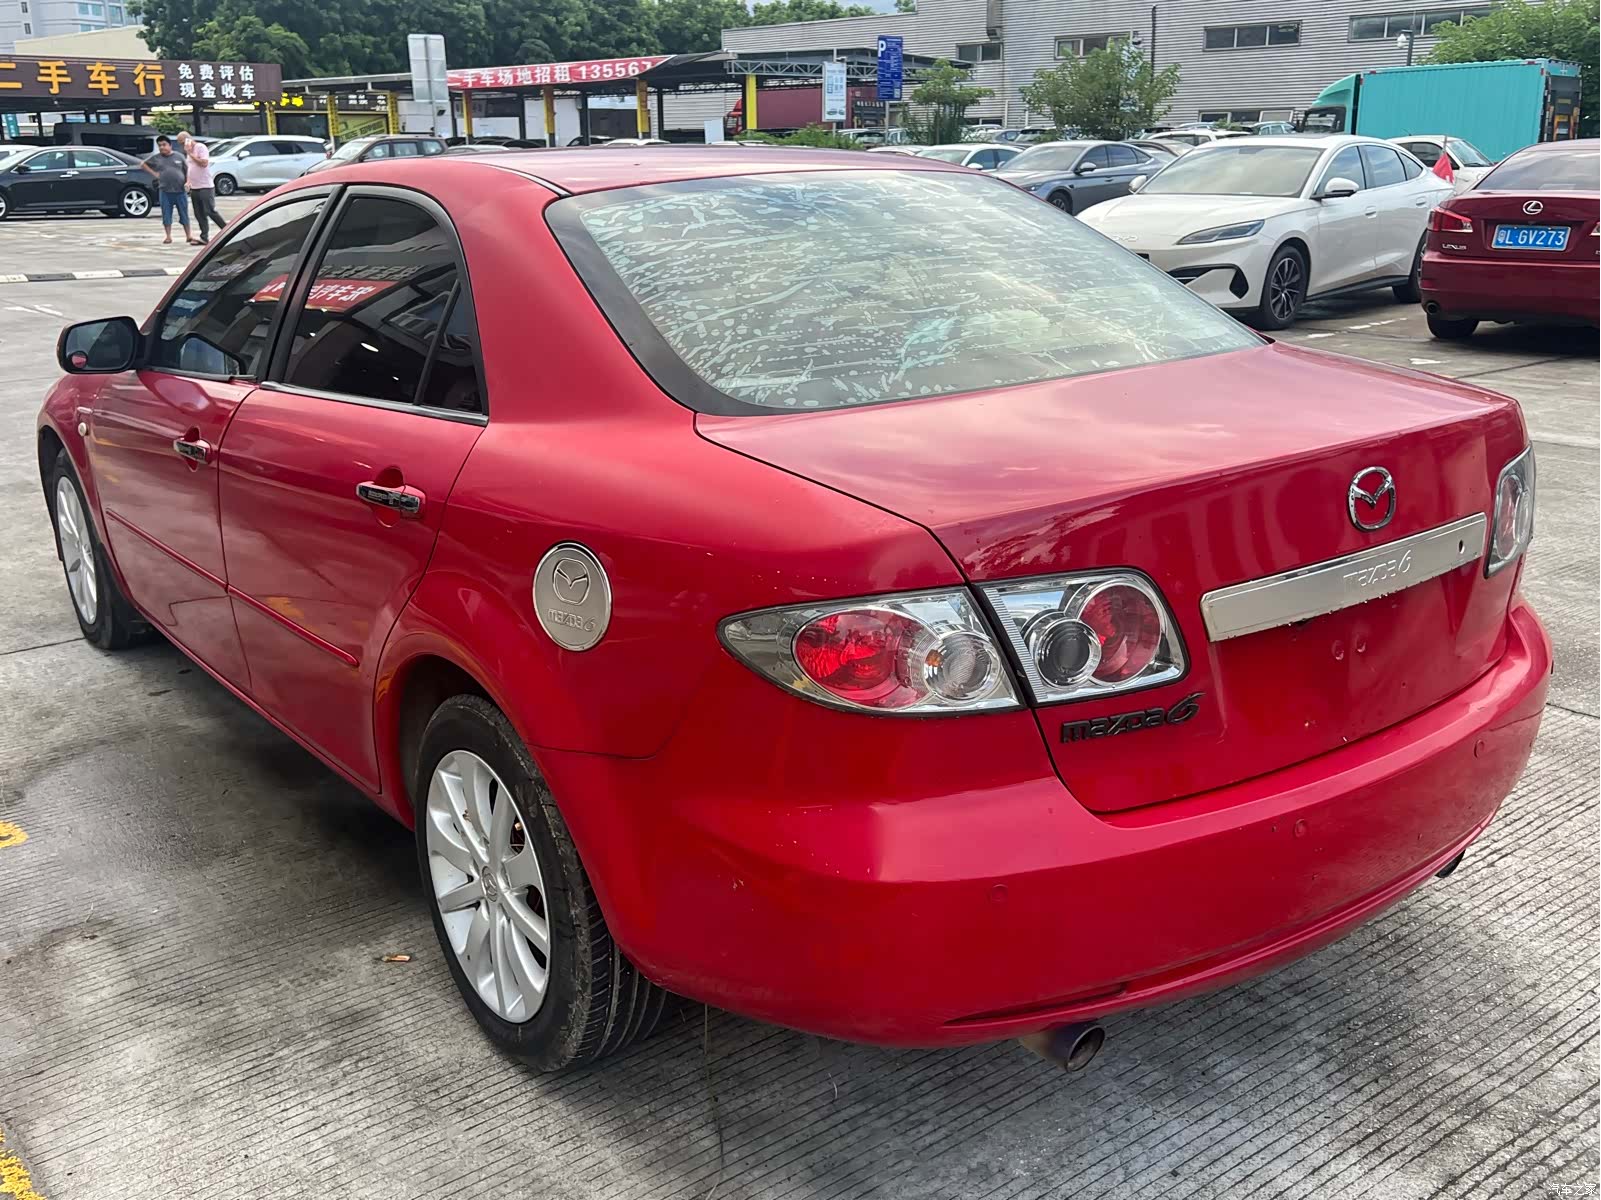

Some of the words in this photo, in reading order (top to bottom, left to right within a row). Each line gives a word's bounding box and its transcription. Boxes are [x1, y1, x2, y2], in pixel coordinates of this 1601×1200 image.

[877, 40, 886, 57] P
[0, 60, 165, 96] 二手车行
[178, 63, 254, 81] 免费评估
[446, 65, 571, 88] 二手车场地招租
[179, 82, 256, 99] 现金收车
